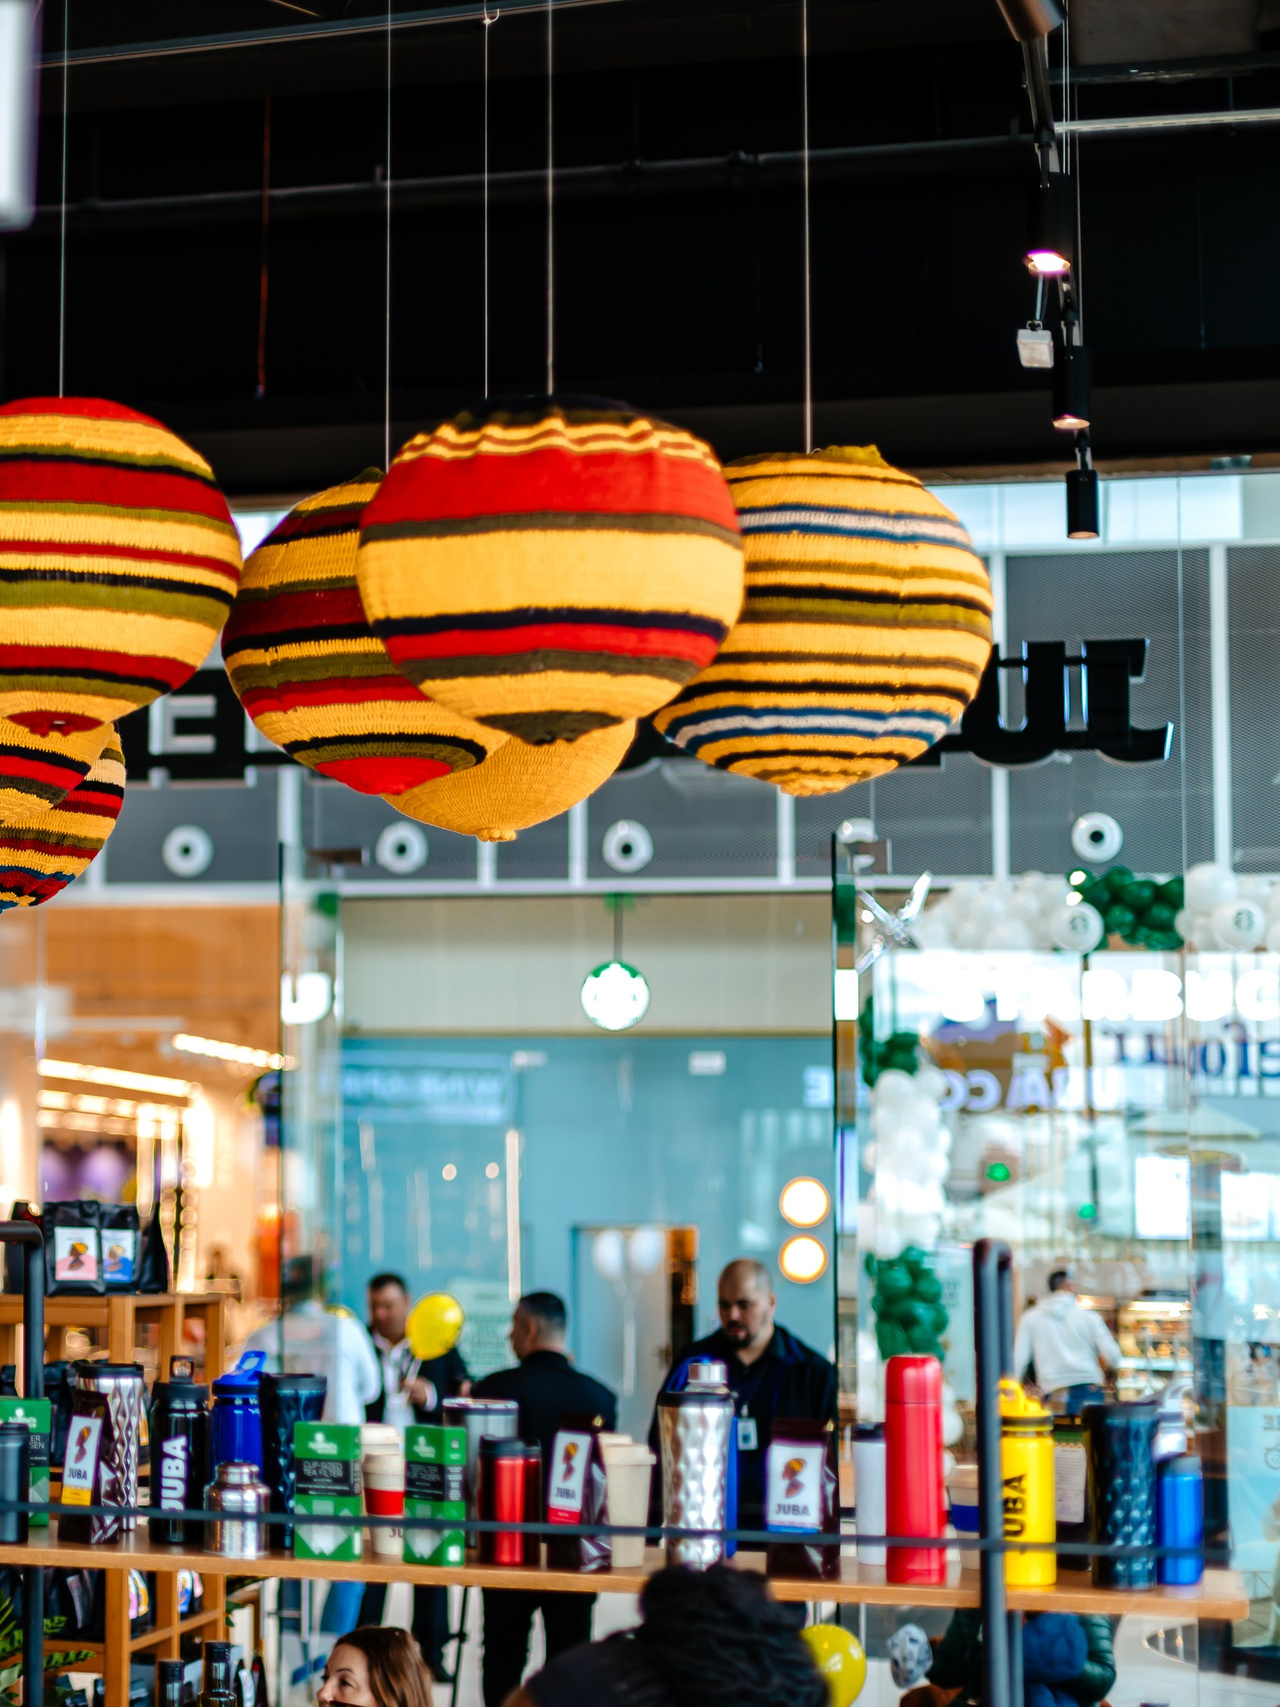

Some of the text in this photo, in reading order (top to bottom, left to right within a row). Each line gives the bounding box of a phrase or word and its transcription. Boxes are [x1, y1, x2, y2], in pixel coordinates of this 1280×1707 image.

[160, 1434, 188, 1510] JUBA
[303, 1460, 343, 1471] CUP-SIZED
[68, 1468, 88, 1481] JUBA
[303, 1468, 344, 1478] TEA FILTER
[554, 1487, 577, 1500] JUBA
[775, 1503, 811, 1516] JUBA
[1002, 1473, 1026, 1539] UBA
